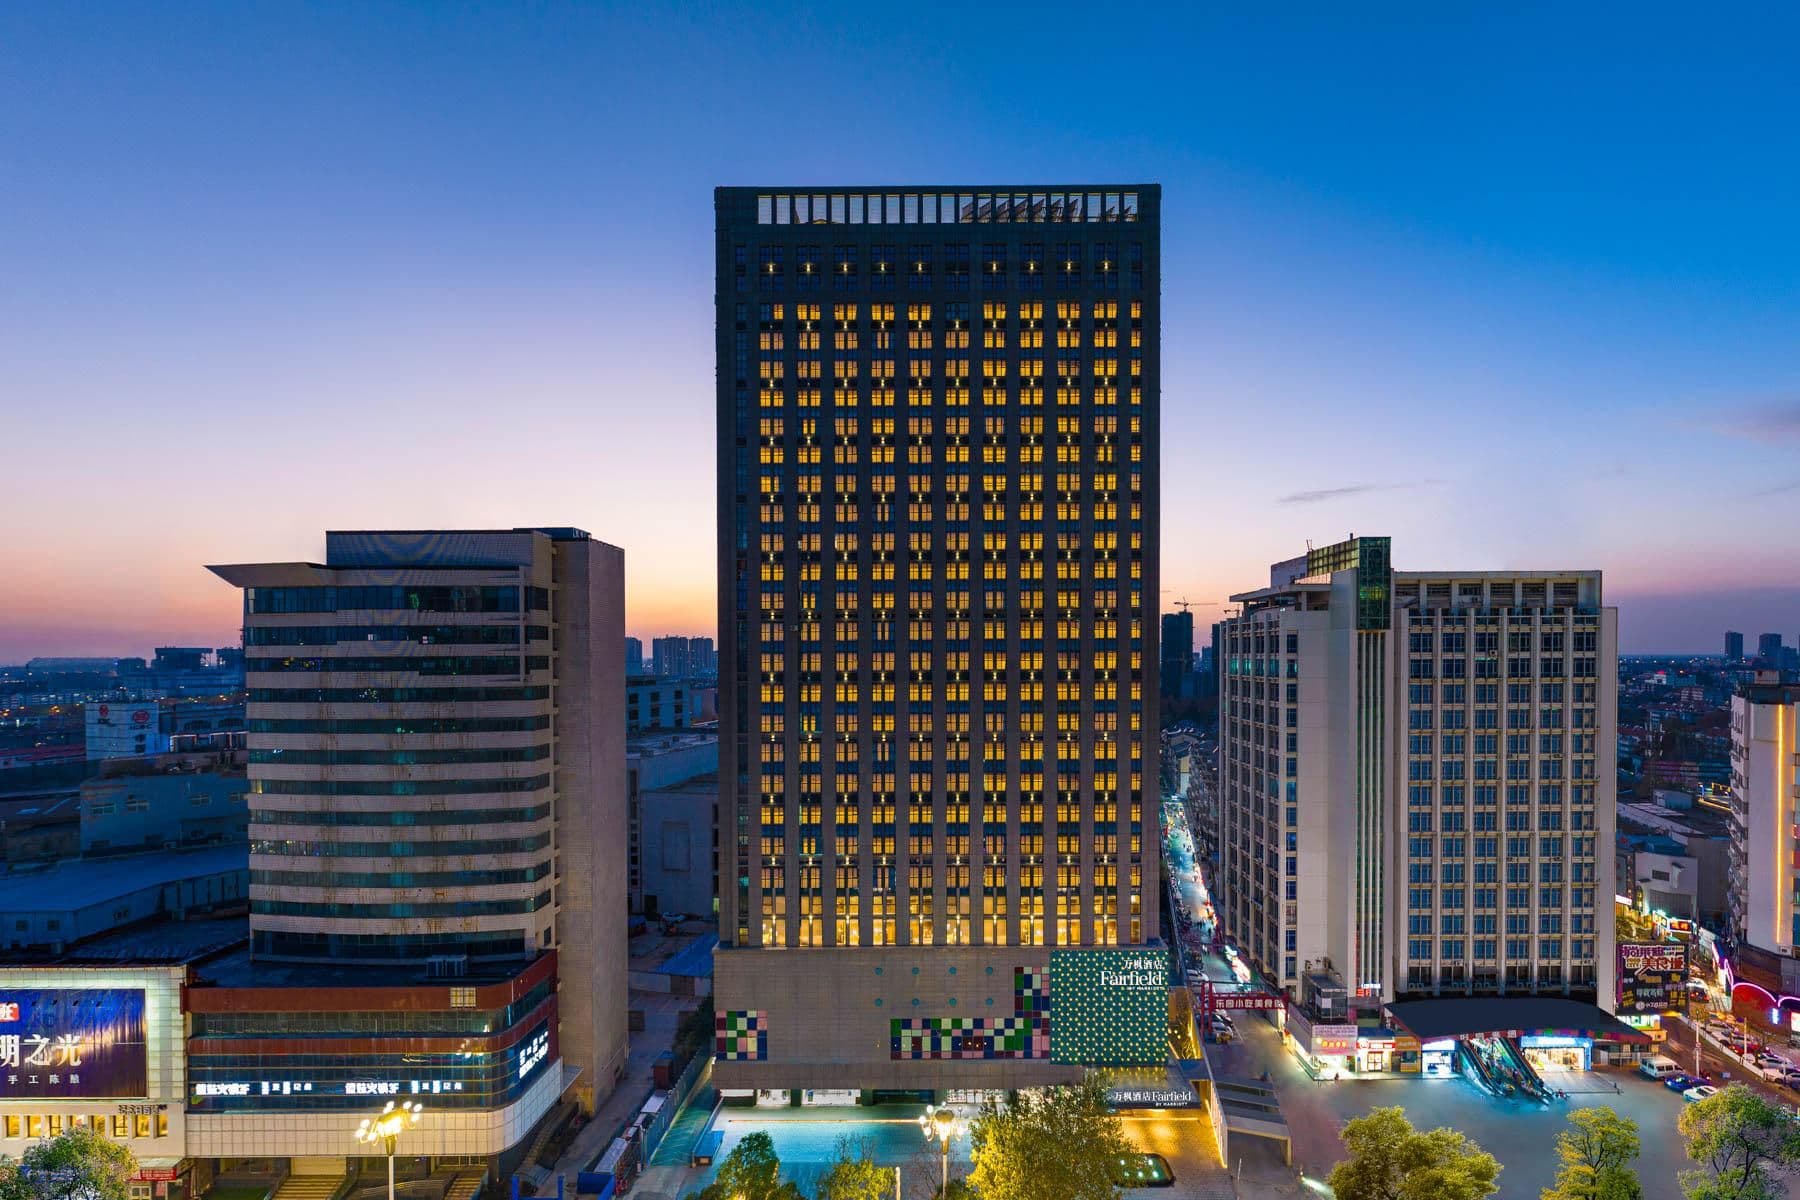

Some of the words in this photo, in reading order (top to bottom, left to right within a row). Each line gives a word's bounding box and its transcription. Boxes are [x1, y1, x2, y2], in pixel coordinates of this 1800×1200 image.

[1124, 959, 1164, 970] 万枫酒店
[1100, 971, 1163, 986] Fairfield
[1115, 1091, 1151, 1102] 万枫酒店
[1152, 1091, 1192, 1101] Fairfield
